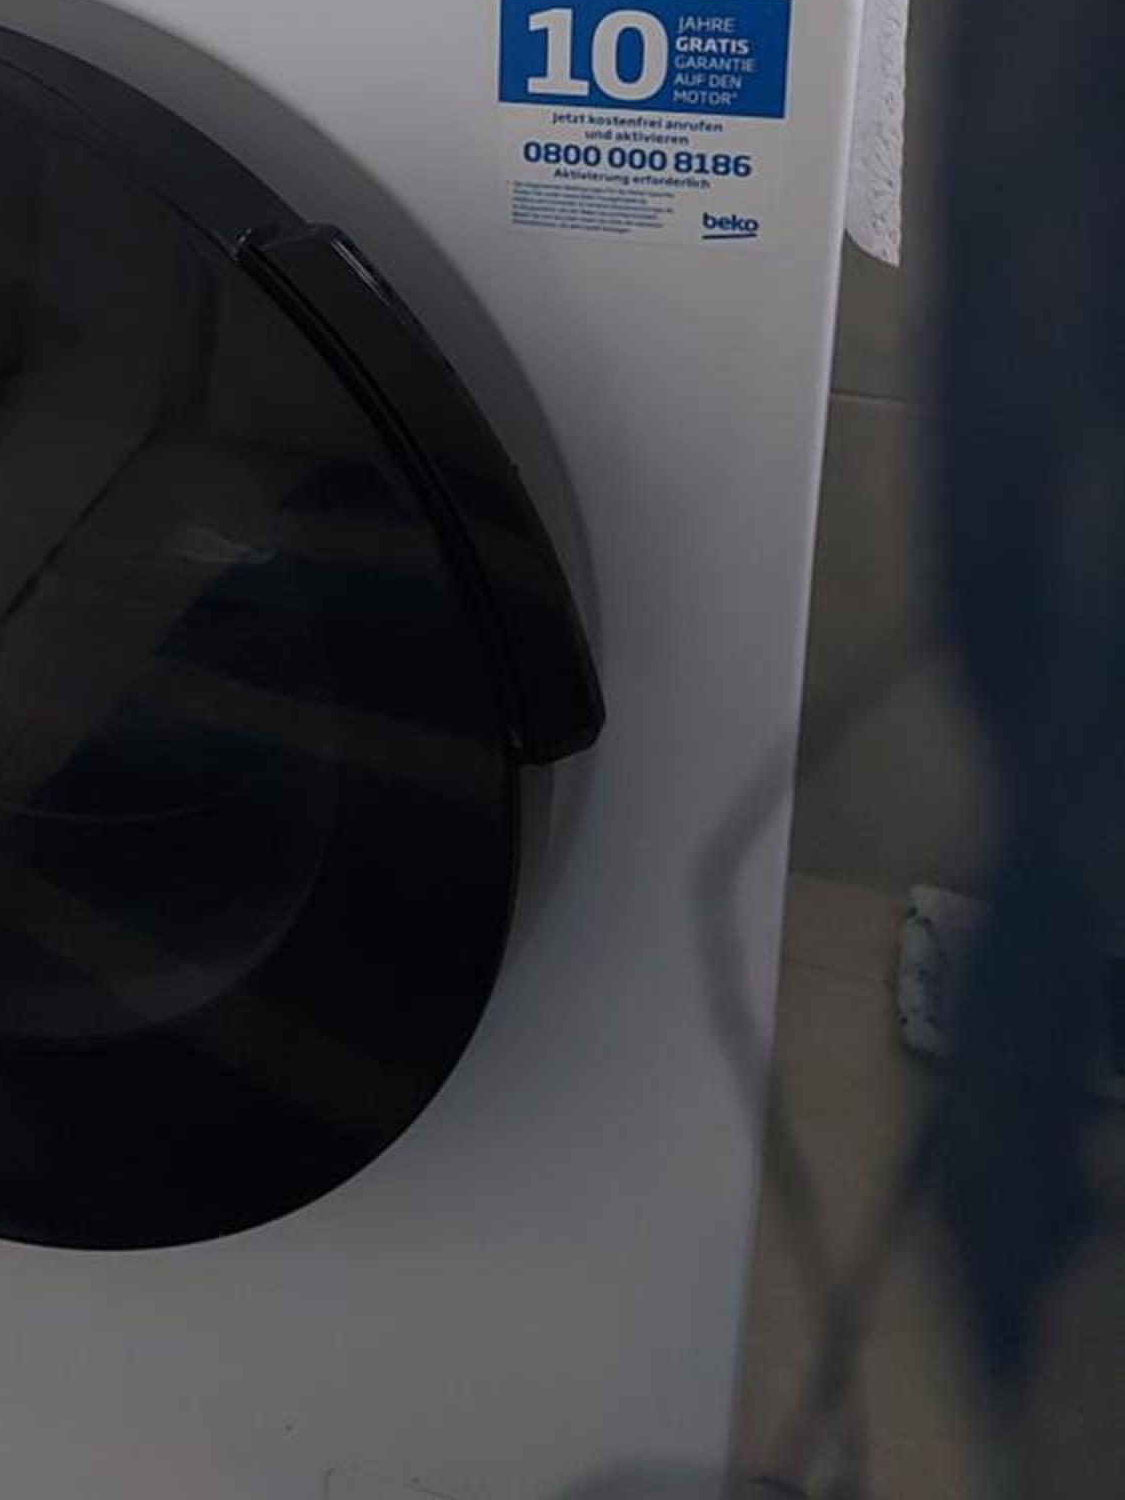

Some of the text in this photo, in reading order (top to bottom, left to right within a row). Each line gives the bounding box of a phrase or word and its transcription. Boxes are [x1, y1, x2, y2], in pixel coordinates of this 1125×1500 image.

[678, 16, 736, 35] JAHRE
[527, 7, 670, 102] 10
[675, 36, 750, 55] GRATIS
[674, 55, 756, 73] GARANTIE
[674, 73, 743, 90] AUF DEN
[552, 111, 724, 134] Jetzt kostenfrei anrufen
[584, 129, 690, 147] und aktivieren
[523, 141, 753, 179] 0800 000 8186
[554, 167, 712, 190] Aktivierung erforderlich
[702, 211, 761, 235] beko
